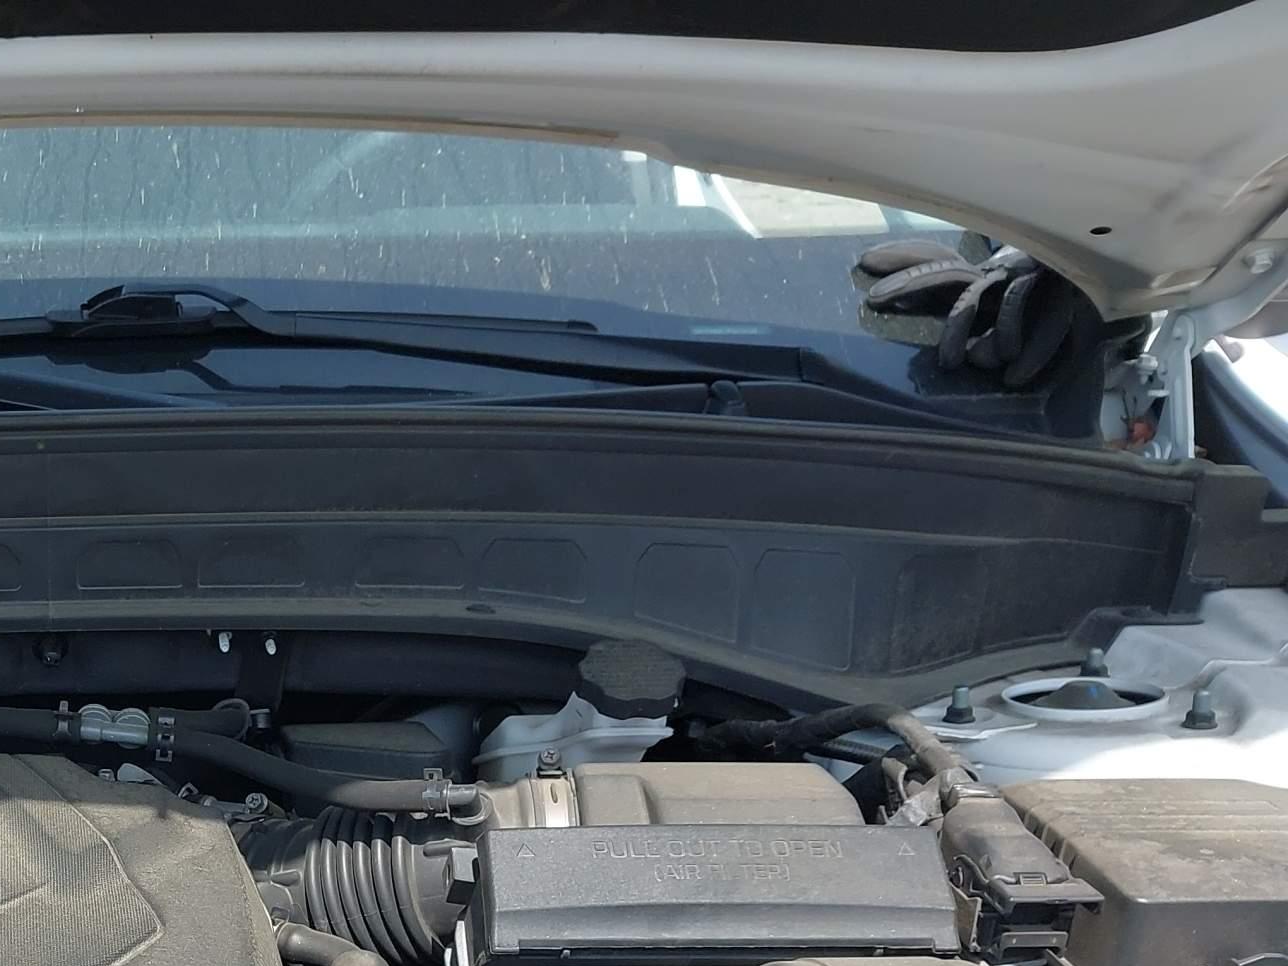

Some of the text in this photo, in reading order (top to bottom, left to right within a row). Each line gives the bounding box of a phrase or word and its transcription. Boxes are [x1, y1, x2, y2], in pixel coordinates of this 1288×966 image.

[591, 839, 844, 858] PULL OUT TO OPEN
[654, 863, 703, 882] (AIR
